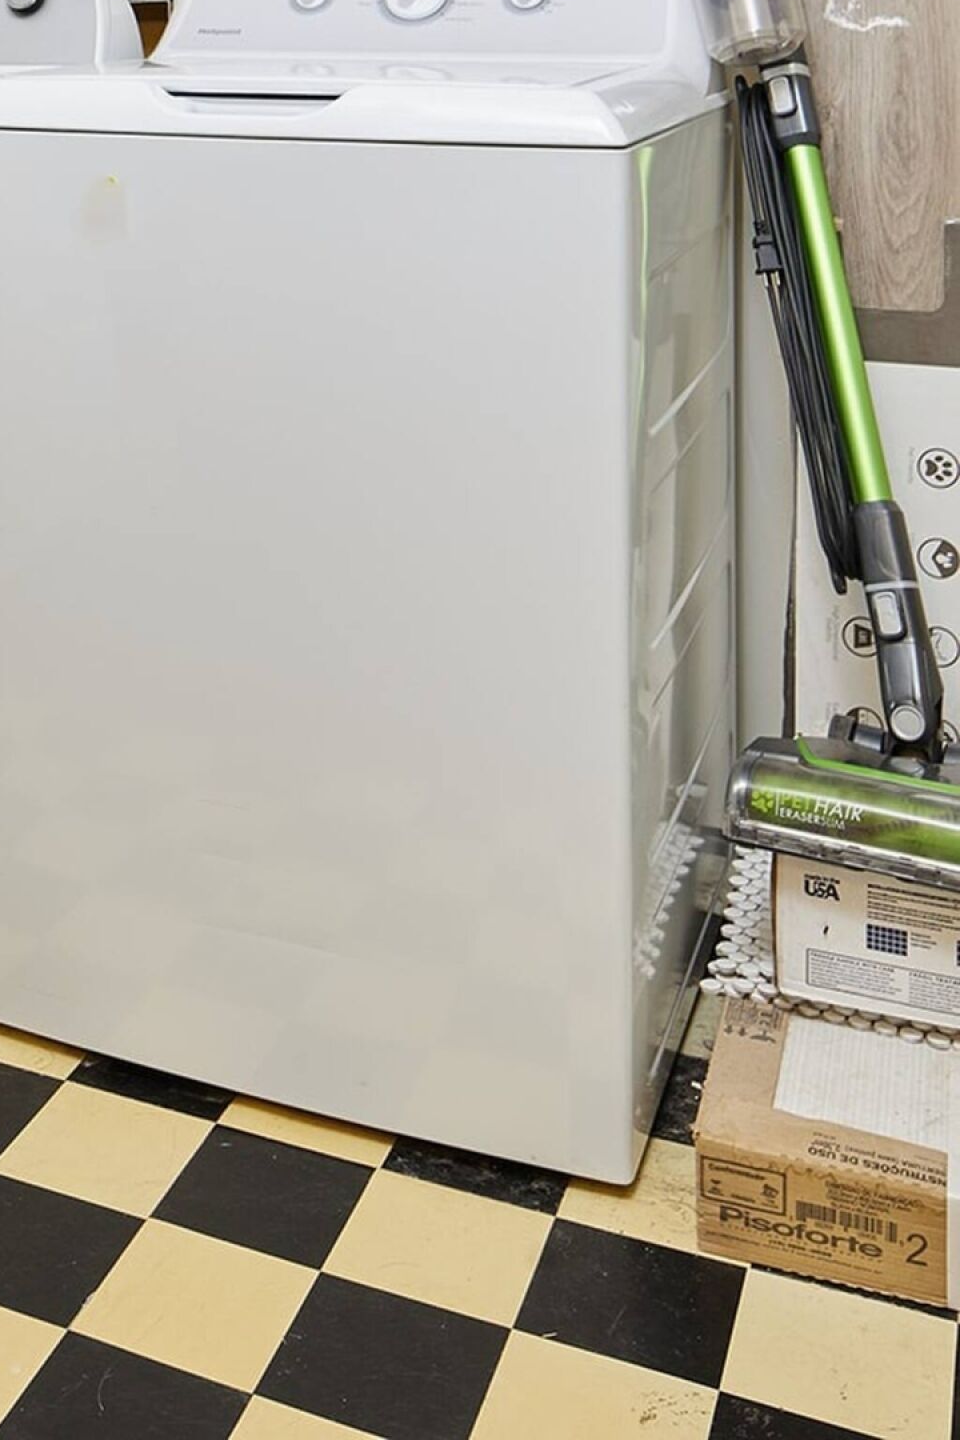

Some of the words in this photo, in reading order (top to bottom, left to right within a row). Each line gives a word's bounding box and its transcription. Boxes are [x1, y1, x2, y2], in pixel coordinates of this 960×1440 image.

[804, 879, 840, 901] USA
[807, 1146, 837, 1160] USO
[863, 1159, 947, 1187] NSTRUÇÕES
[719, 1205, 883, 1258] Pisoforte
[906, 1233, 929, 1266] 2
